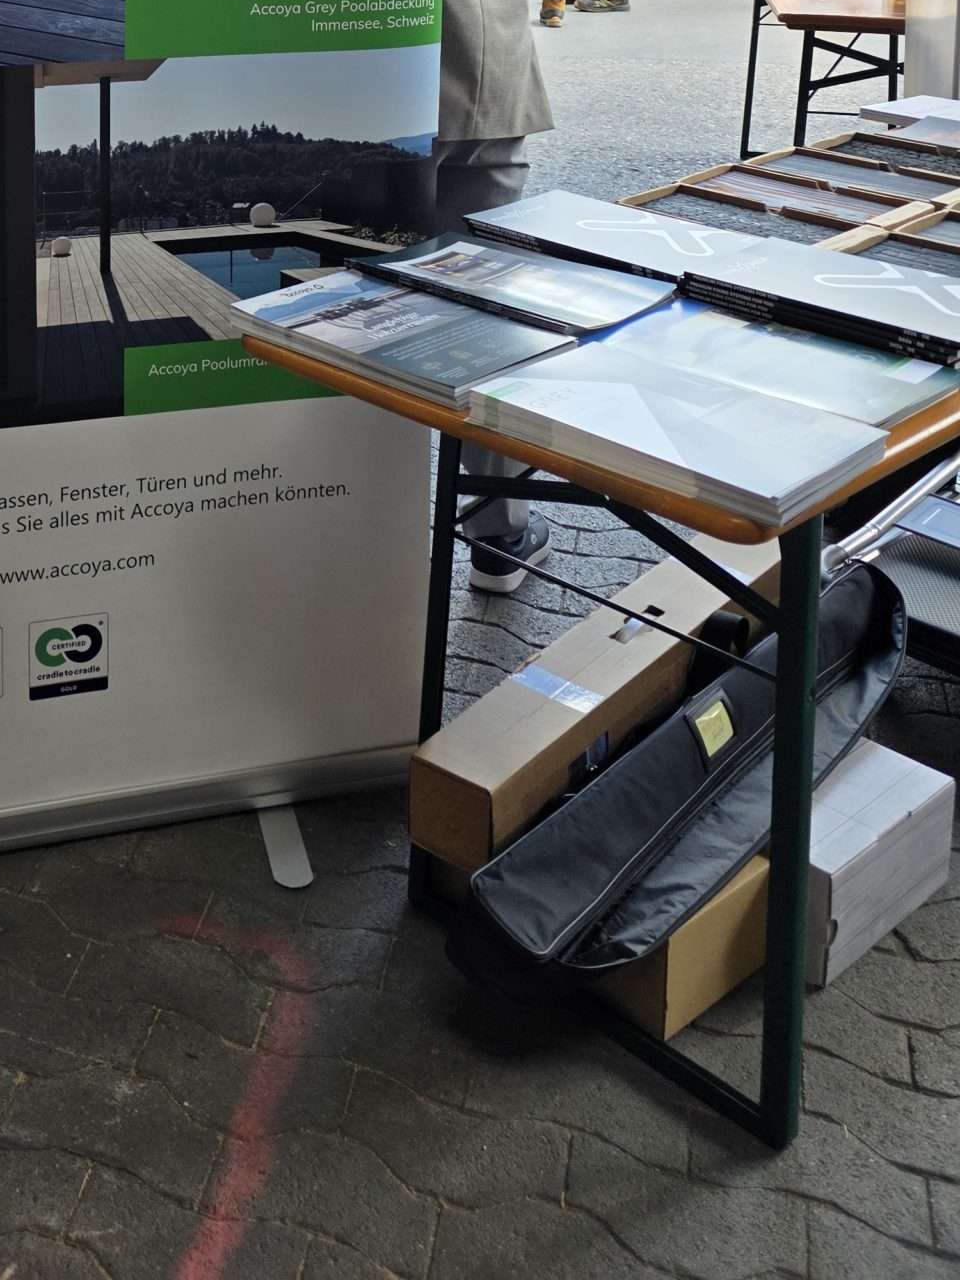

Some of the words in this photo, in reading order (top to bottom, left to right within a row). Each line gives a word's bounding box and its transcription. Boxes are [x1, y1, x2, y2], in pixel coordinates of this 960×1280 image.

[250, 2, 301, 18] Accoya
[304, 1, 336, 16] Grey
[311, 18, 383, 31] Immensee,
[386, 13, 435, 28] Schweiz
[148, 362, 198, 377] Accoya
[59, 482, 130, 503] Fenster,
[136, 473, 187, 494] Türen
[192, 468, 227, 488] und
[232, 464, 283, 483] mehr.
[16, 515, 44, 532] Sie
[49, 510, 89, 528] alles
[96, 505, 125, 524] mit
[130, 499, 194, 519] Accoya
[200, 489, 269, 511] machen
[274, 481, 351, 503] könnten.
[0, 553, 155, 585] www.accoya.com
[52, 639, 87, 651] CERTIFIED
